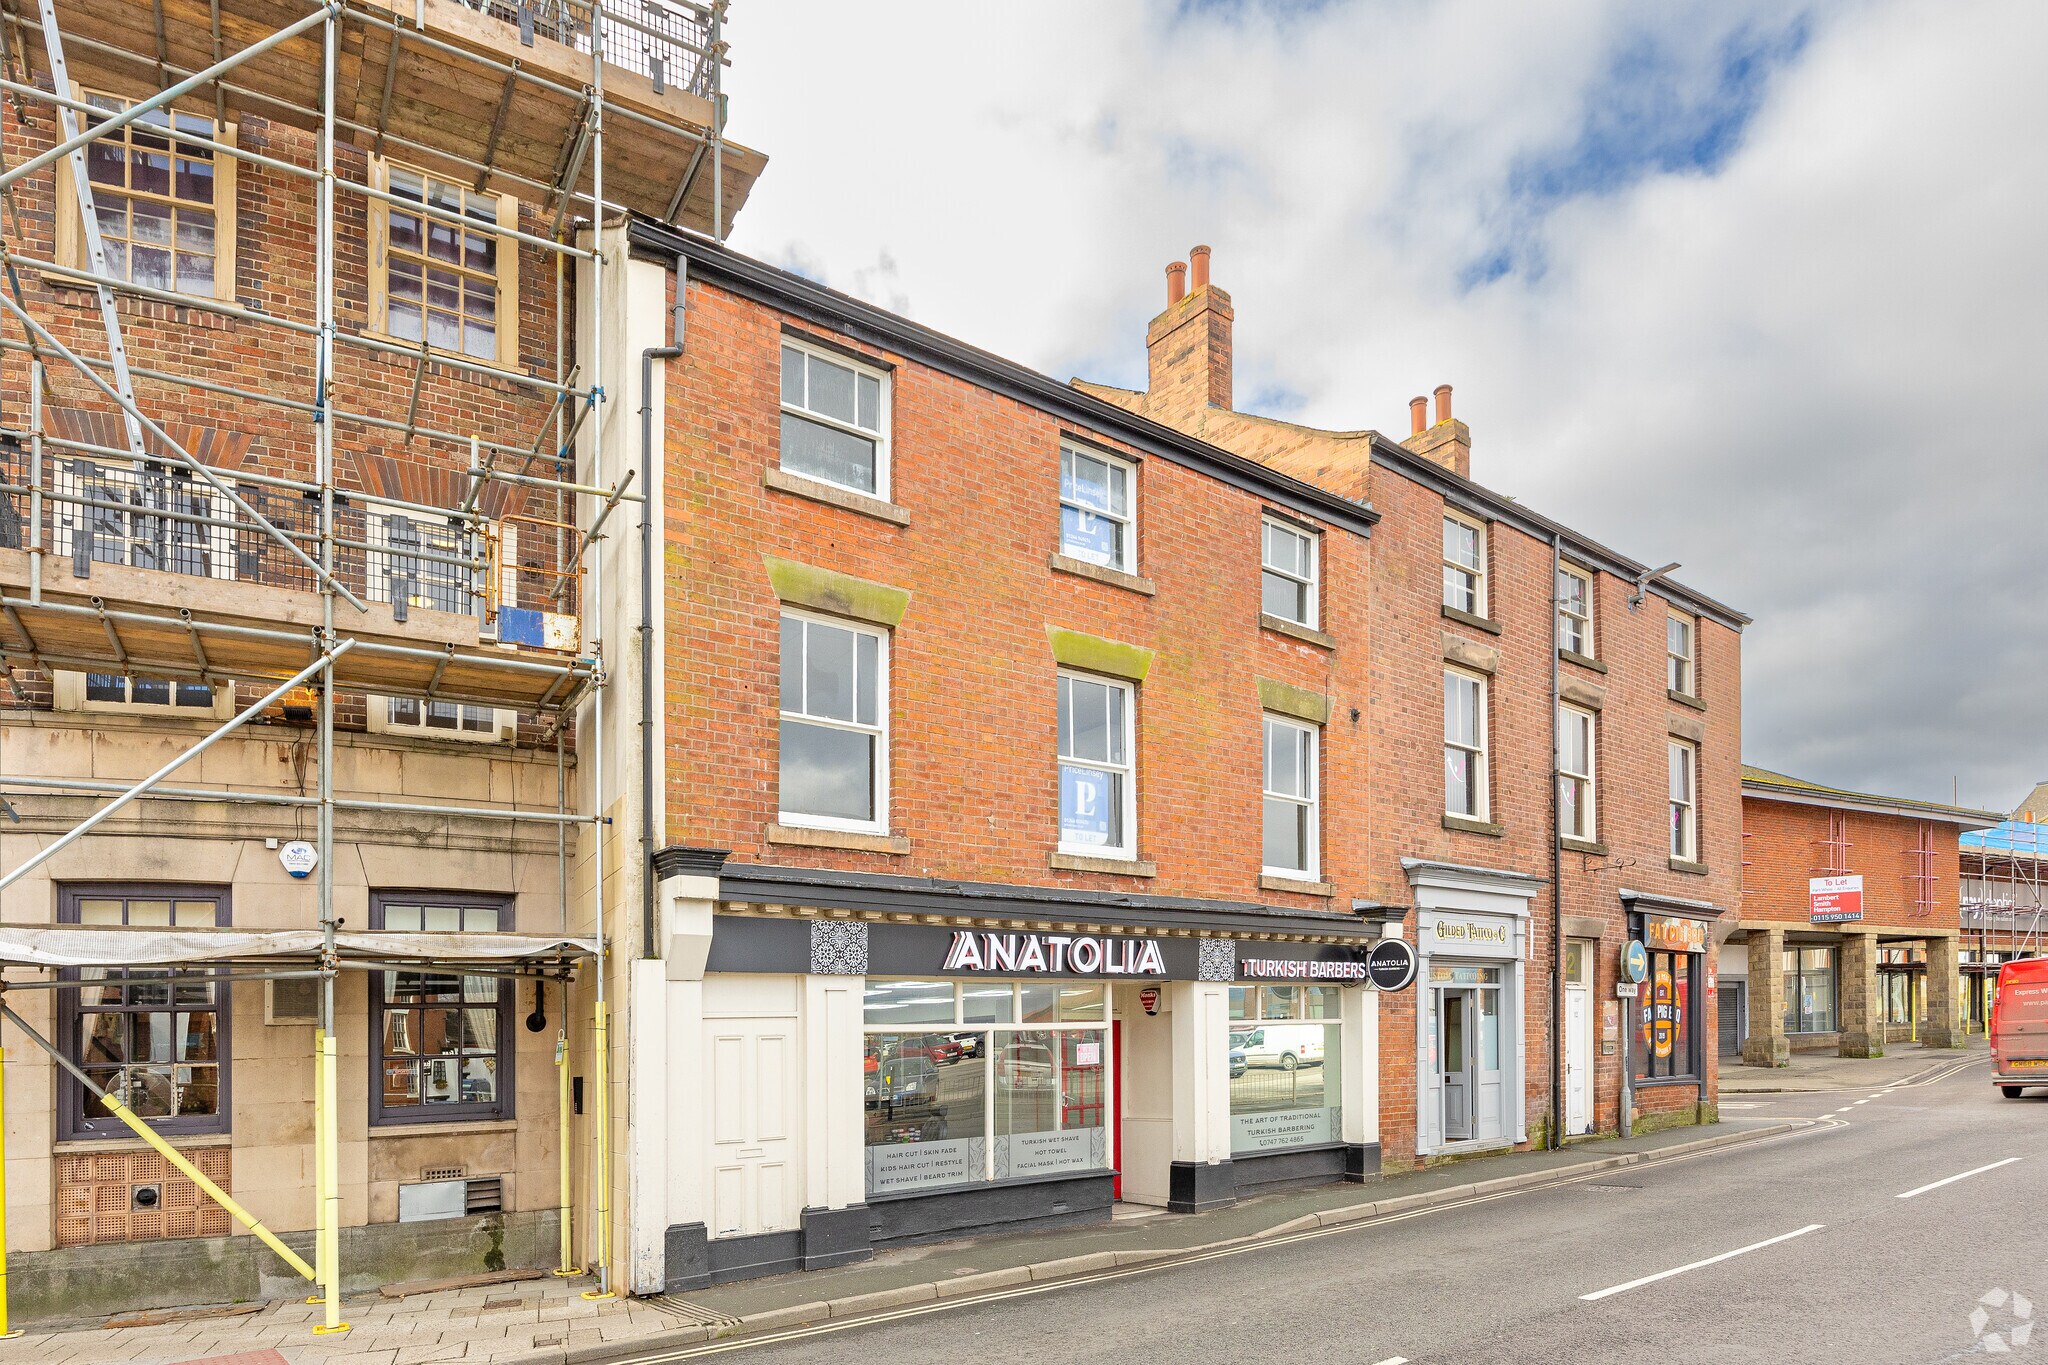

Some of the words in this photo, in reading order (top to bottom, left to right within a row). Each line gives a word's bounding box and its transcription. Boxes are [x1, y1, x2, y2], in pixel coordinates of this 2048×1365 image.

[1836, 878, 1848, 886] Let
[1814, 906, 1841, 914] Hampton
[1844, 912, 1860, 920] 1414
[1650, 922, 1667, 941] FAT
[1669, 925, 1684, 942] PIG
[943, 931, 1167, 975] ANATOLIA
[1242, 958, 1308, 978] TURKISH
[1310, 960, 1366, 979] BARBERS
[1628, 987, 1636, 995] way
[2014, 988, 2040, 997] Express
[1644, 1006, 1652, 1024] FA
[1658, 1004, 1668, 1019] PIG
[1280, 1112, 1321, 1122] TRADITIONAL
[1248, 1128, 1277, 1136] TURKISH
[1278, 1124, 1315, 1133] BARBERING
[1022, 1138, 1046, 1146] TURKISH
[936, 1158, 963, 1167] RESTYLE
[1038, 1160, 1054, 1168] MASK
[896, 1176, 918, 1184] SHAVE
[924, 1172, 946, 1180] BEARD
